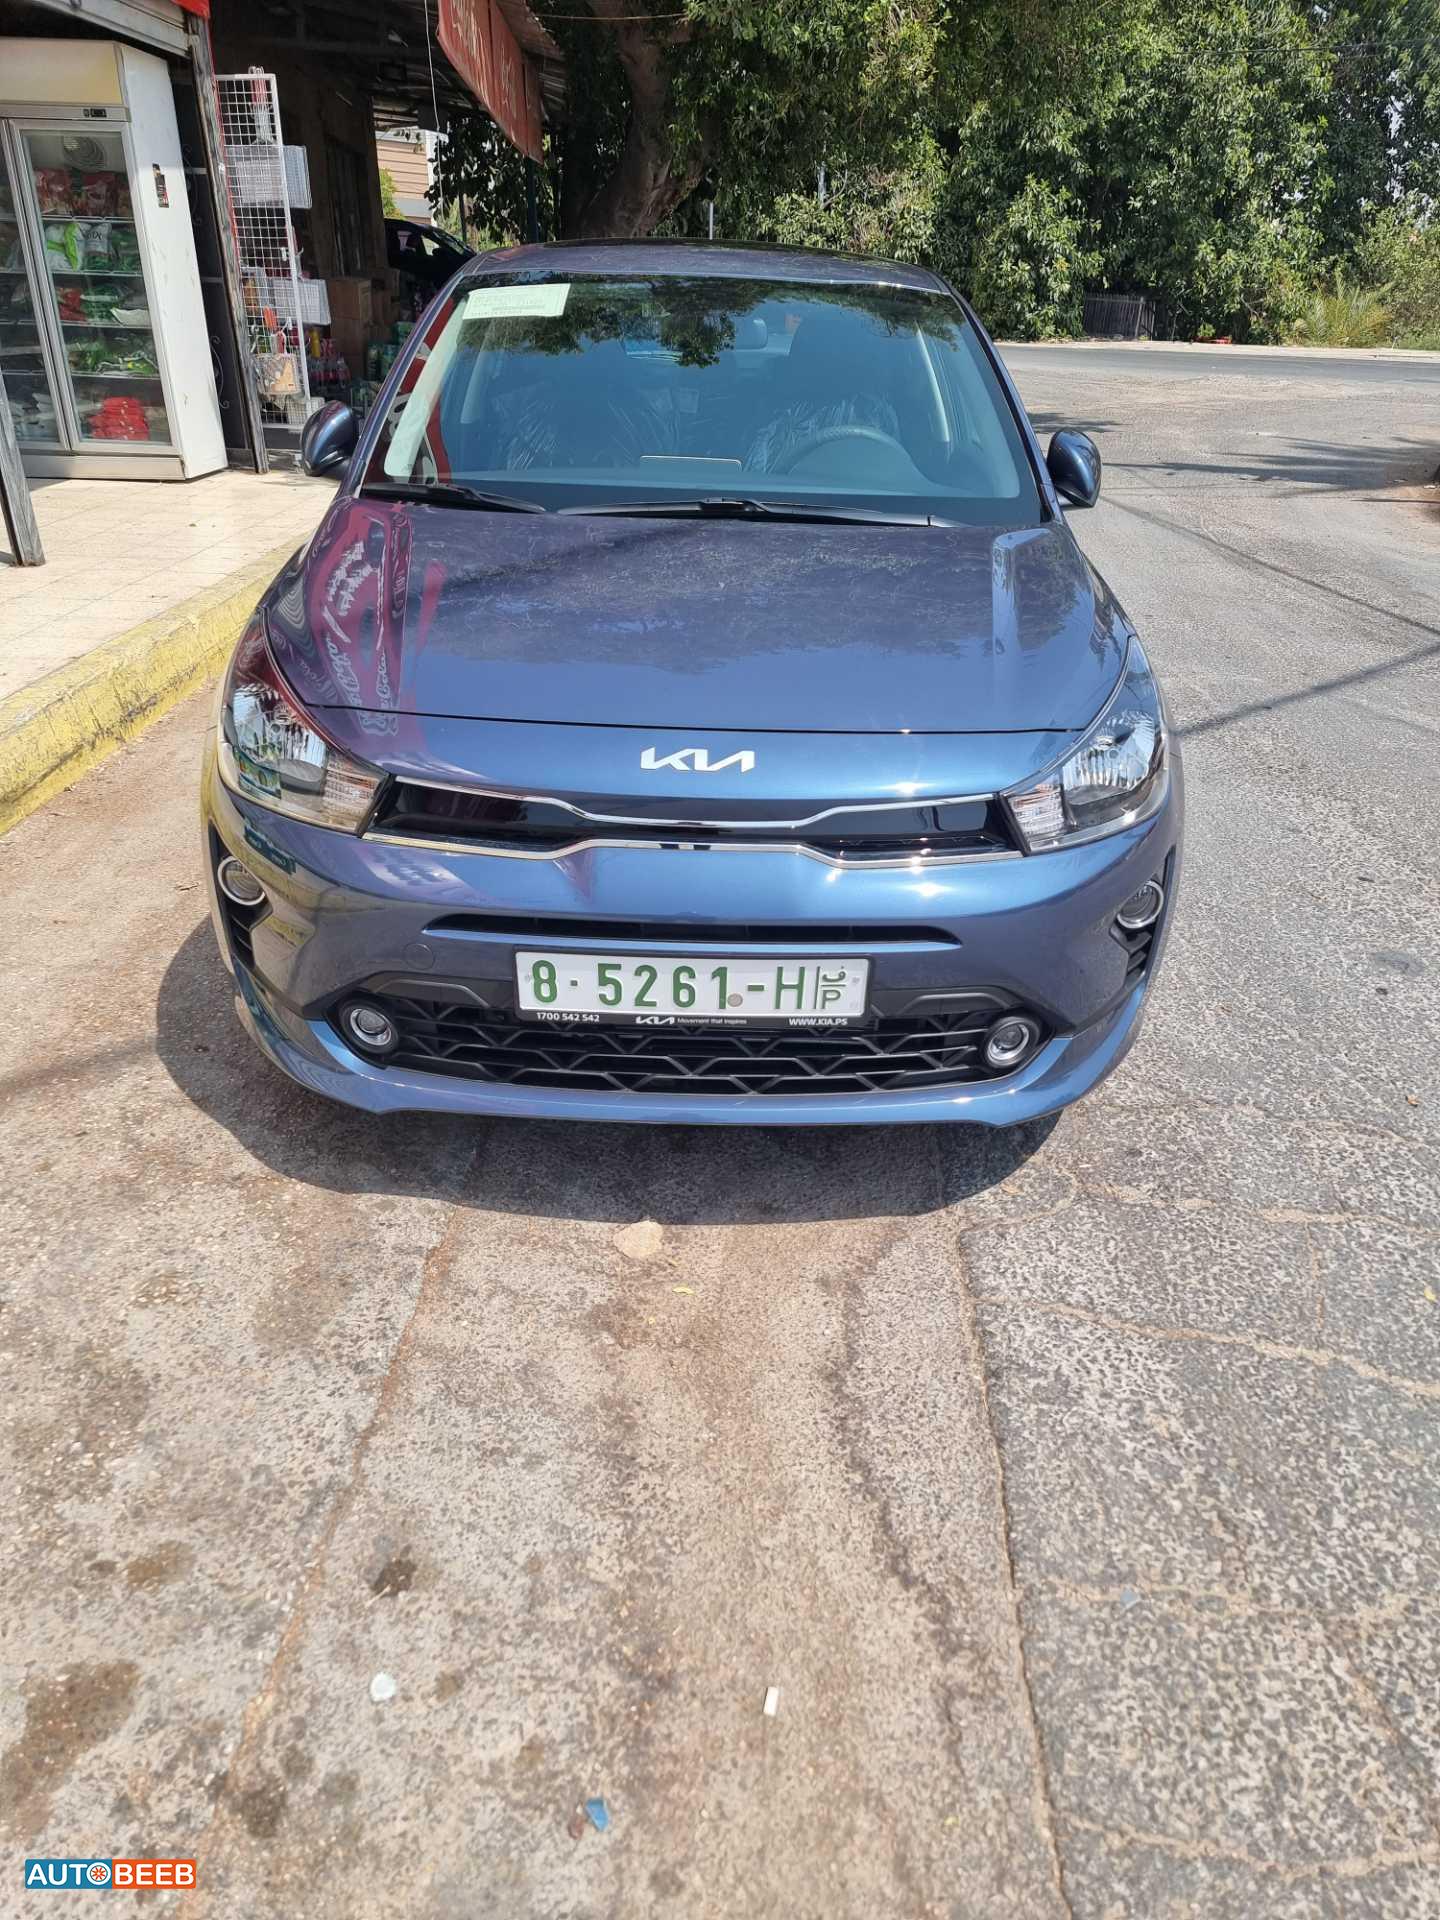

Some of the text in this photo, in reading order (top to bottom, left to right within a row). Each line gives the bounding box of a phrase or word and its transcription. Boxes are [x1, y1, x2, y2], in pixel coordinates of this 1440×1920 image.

[640, 746, 755, 773] KIA
[536, 1011, 600, 1022] 1700 542 542
[636, 1016, 675, 1025] KIA
[788, 1018, 848, 1026] WWW.KIA.PS
